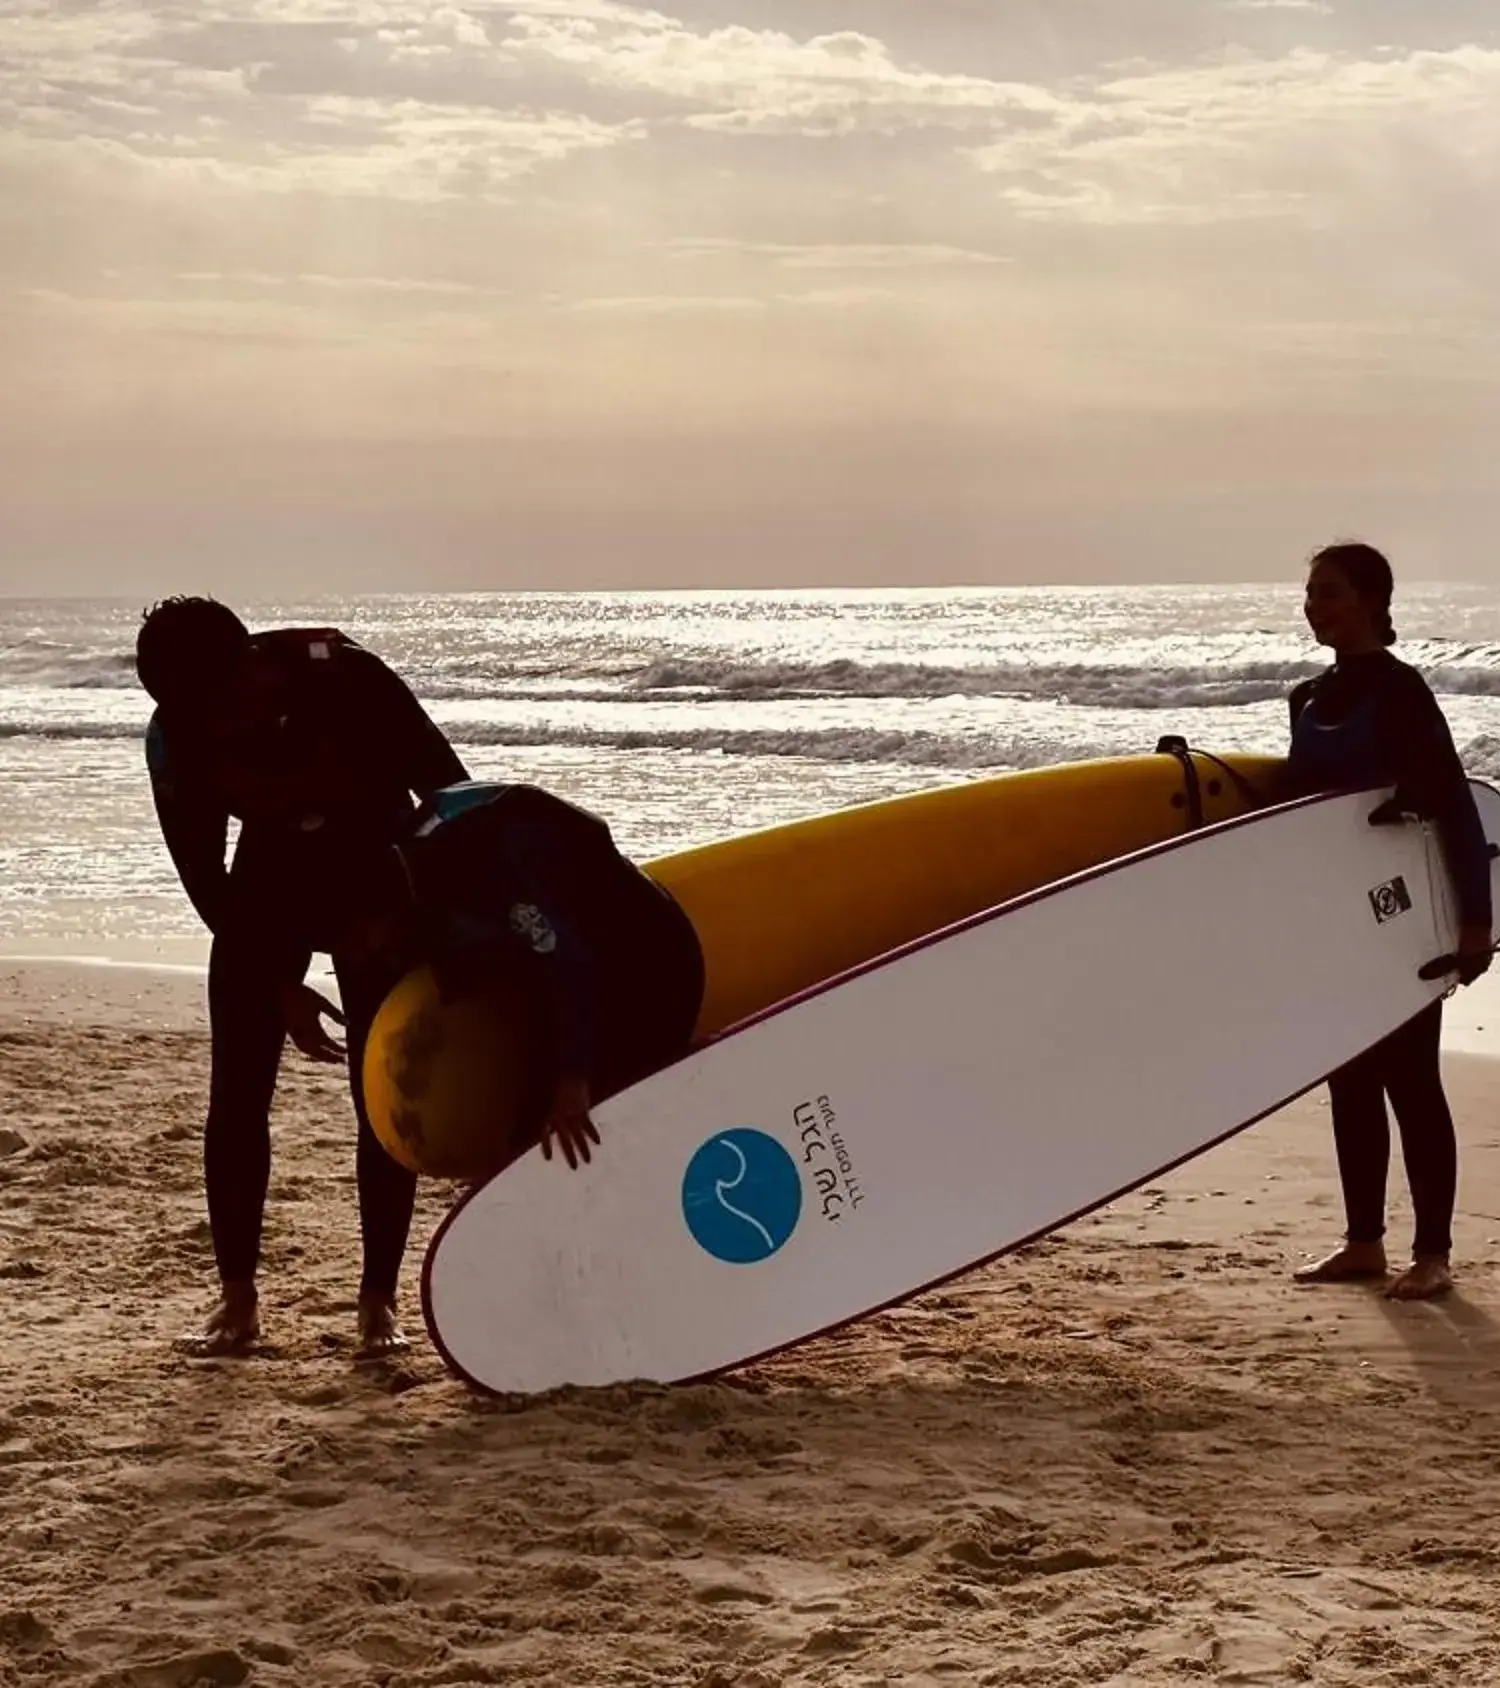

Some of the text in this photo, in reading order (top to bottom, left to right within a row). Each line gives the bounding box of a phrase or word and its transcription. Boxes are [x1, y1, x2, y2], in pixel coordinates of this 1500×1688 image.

[793, 1101, 844, 1221] הגל שלי
[817, 1094, 836, 1130] נוער
[843, 1177, 865, 1210] דרך
